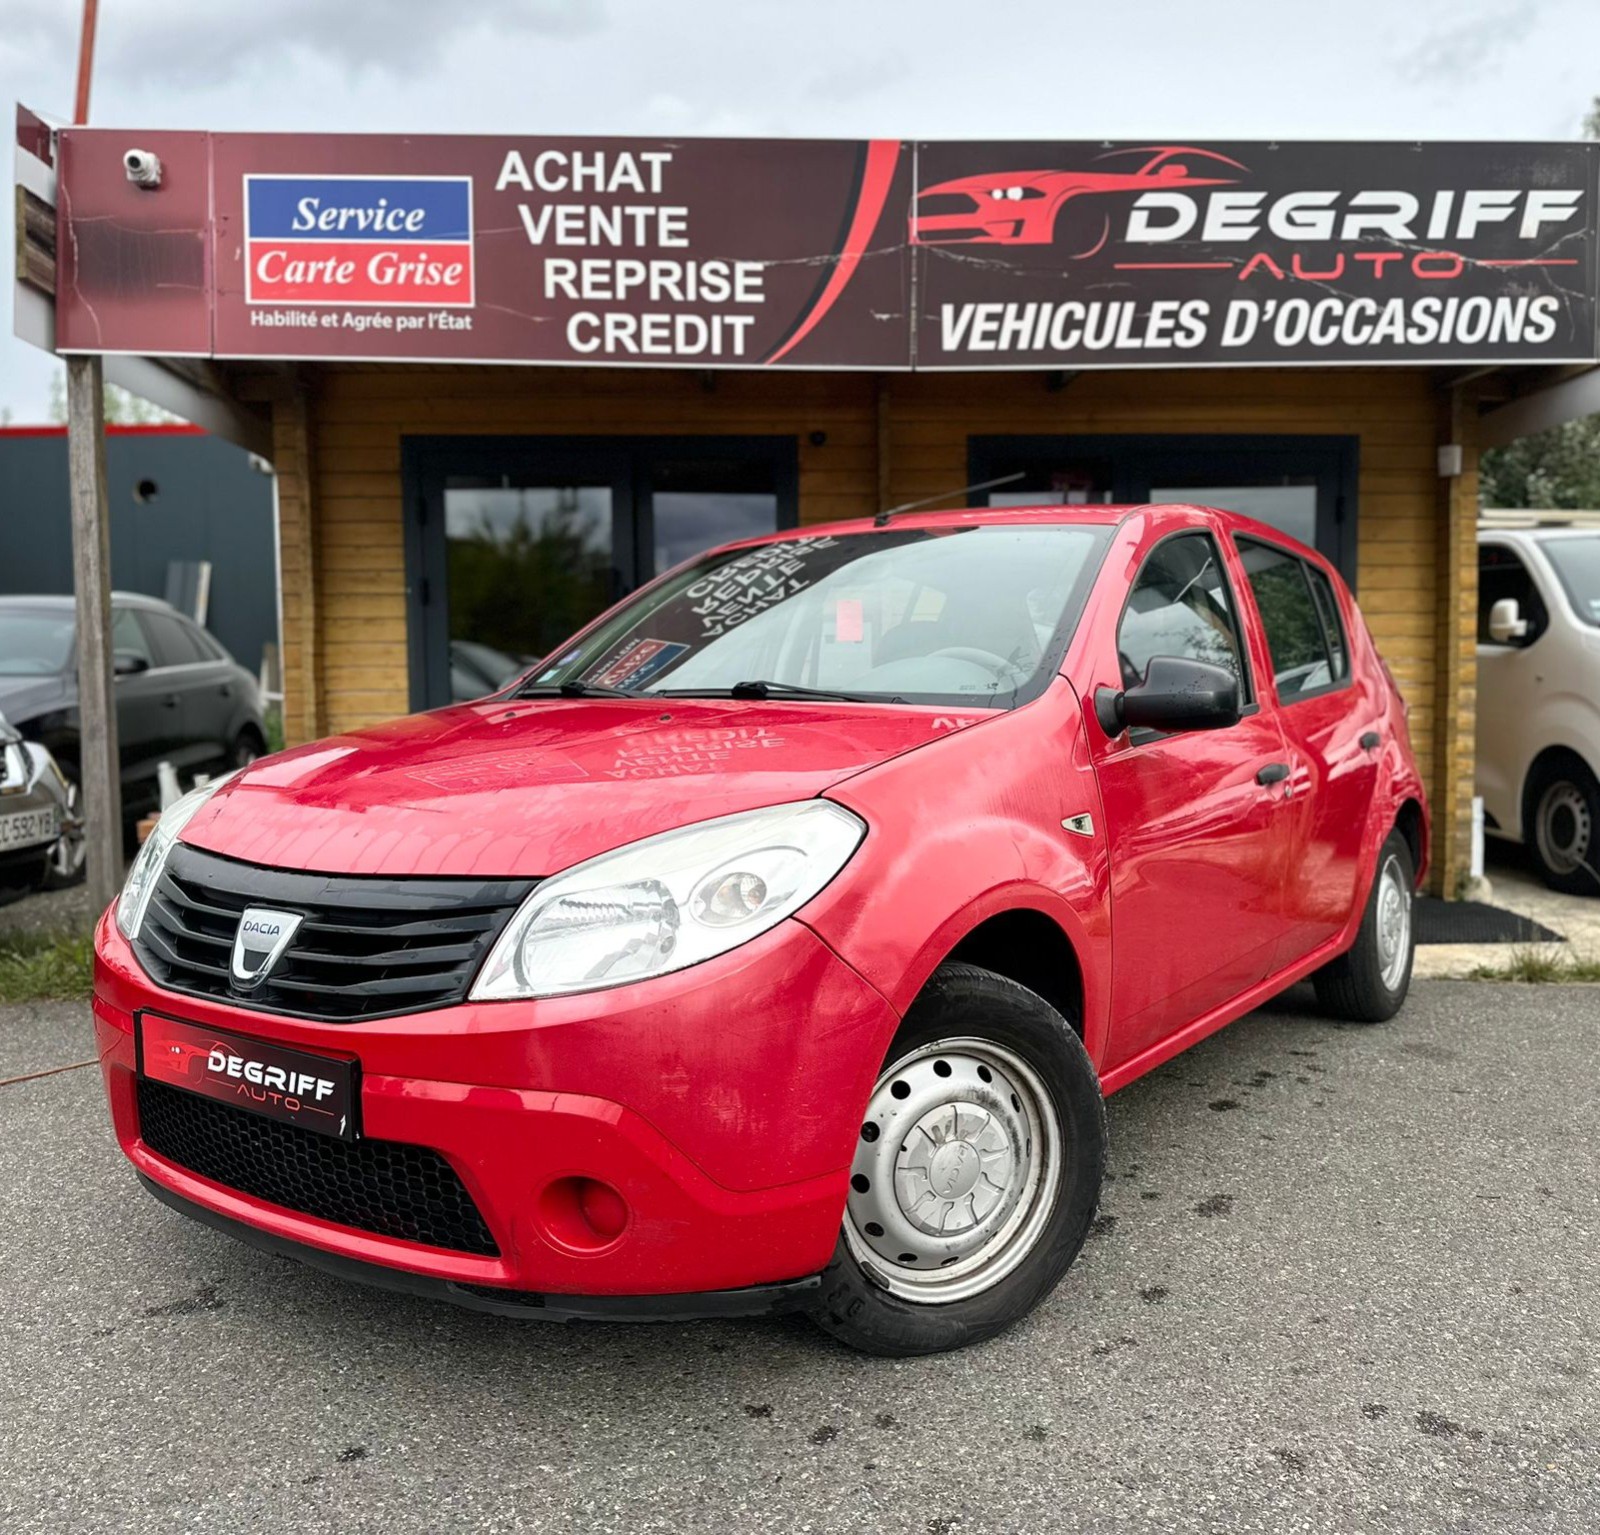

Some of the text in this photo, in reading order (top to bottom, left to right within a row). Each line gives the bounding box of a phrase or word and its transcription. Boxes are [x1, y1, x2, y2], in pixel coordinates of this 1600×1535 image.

[495, 150, 672, 193] ACHAT
[292, 197, 425, 232] Service
[518, 204, 689, 248] VENTE
[1125, 188, 1585, 242] DEGRIFF
[256, 250, 464, 287] Carte Grise
[544, 258, 766, 303] REPRISE
[1238, 251, 1464, 280] AUTO
[250, 310, 473, 332] Habilité et Agrée par l'État
[566, 311, 755, 356] CREDIT
[940, 295, 1559, 350] VEHICULES D'OCCASIONS
[242, 920, 280, 937] DACIA
[207, 1050, 336, 1101] DEGRIFF
[236, 1083, 301, 1112] AUTO
